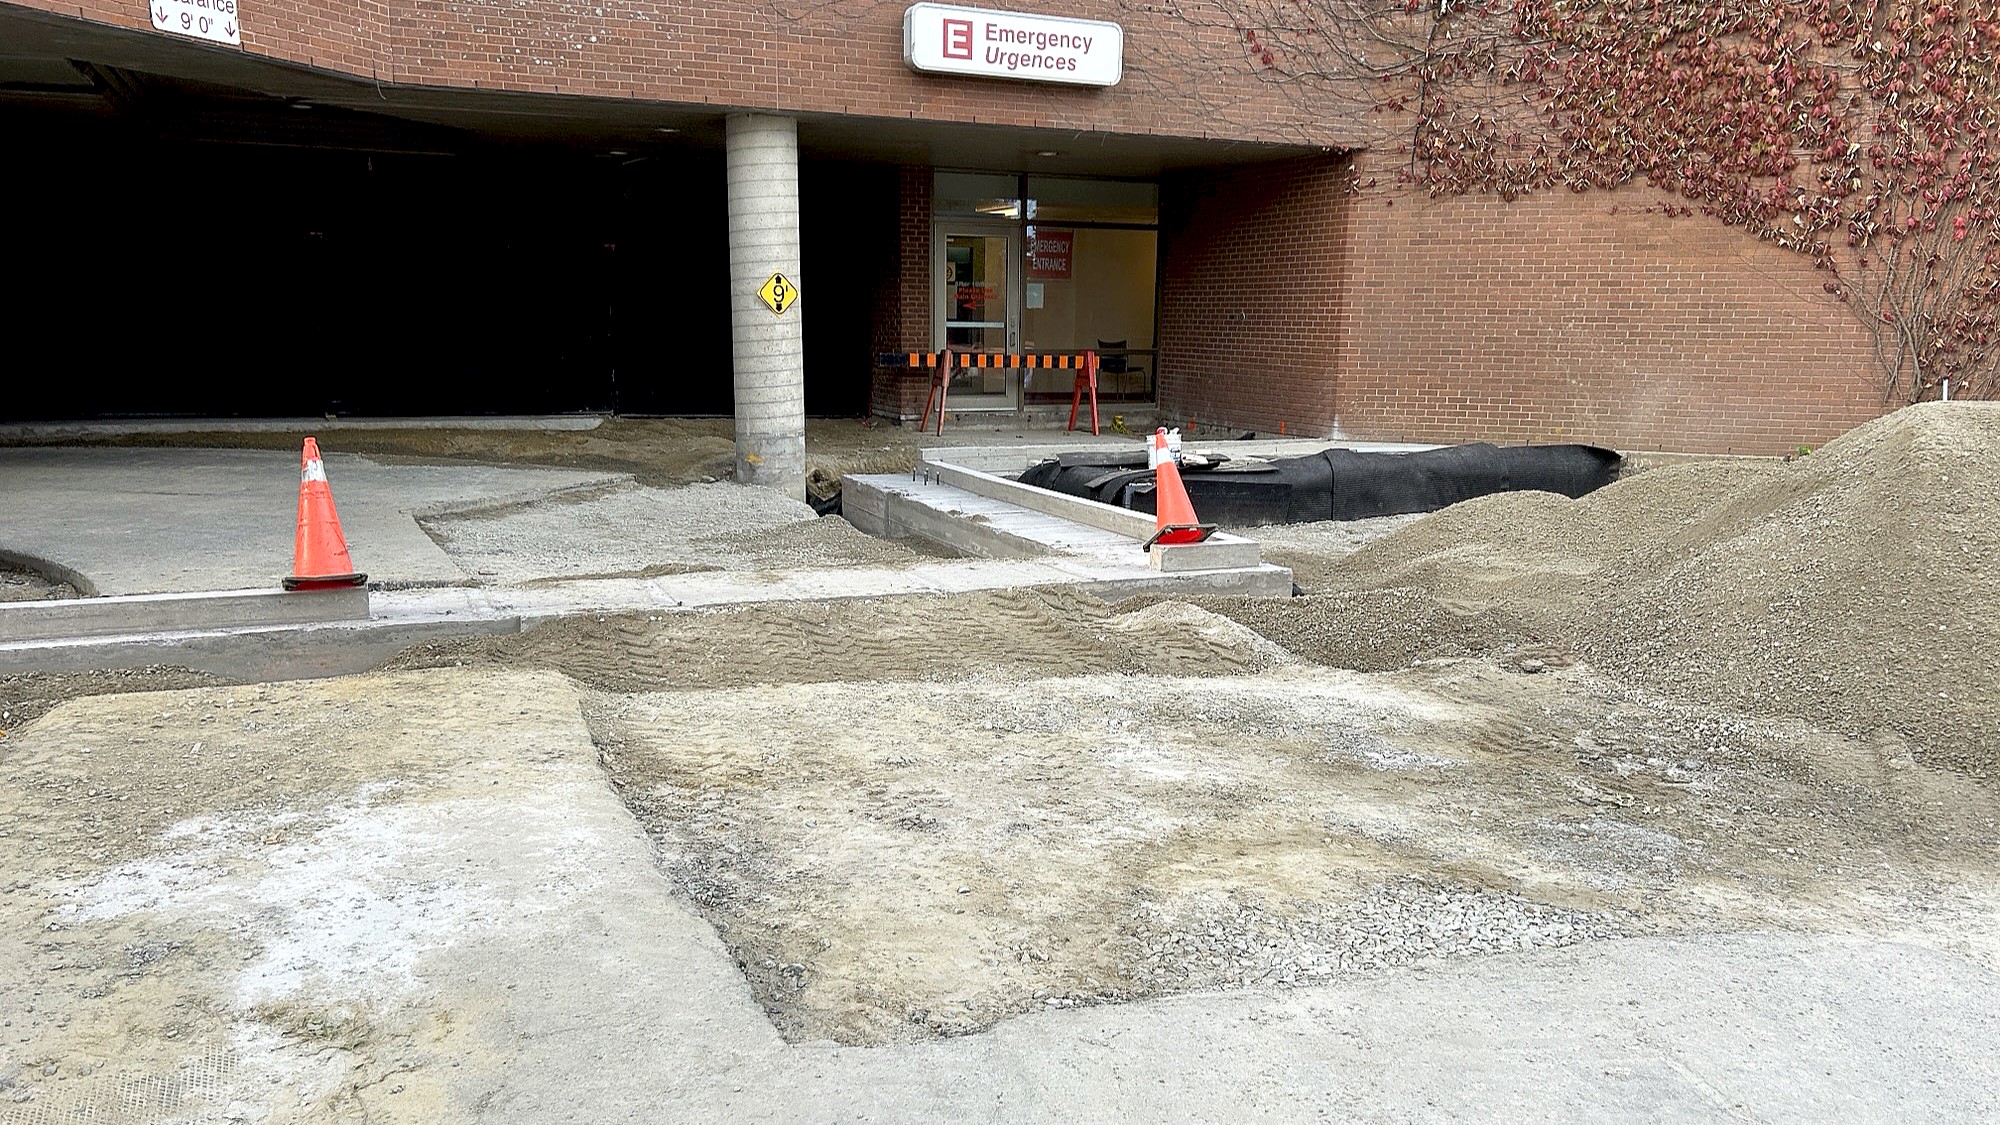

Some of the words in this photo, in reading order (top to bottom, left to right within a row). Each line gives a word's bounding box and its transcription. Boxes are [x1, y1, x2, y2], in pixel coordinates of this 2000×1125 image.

[181, 12, 193, 30] 9'
[946, 20, 970, 57] E
[985, 22, 1093, 54] Emergency
[985, 46, 1077, 71] Urgences
[1032, 256, 1067, 271] ENTRANCE
[773, 284, 789, 303] 9'
